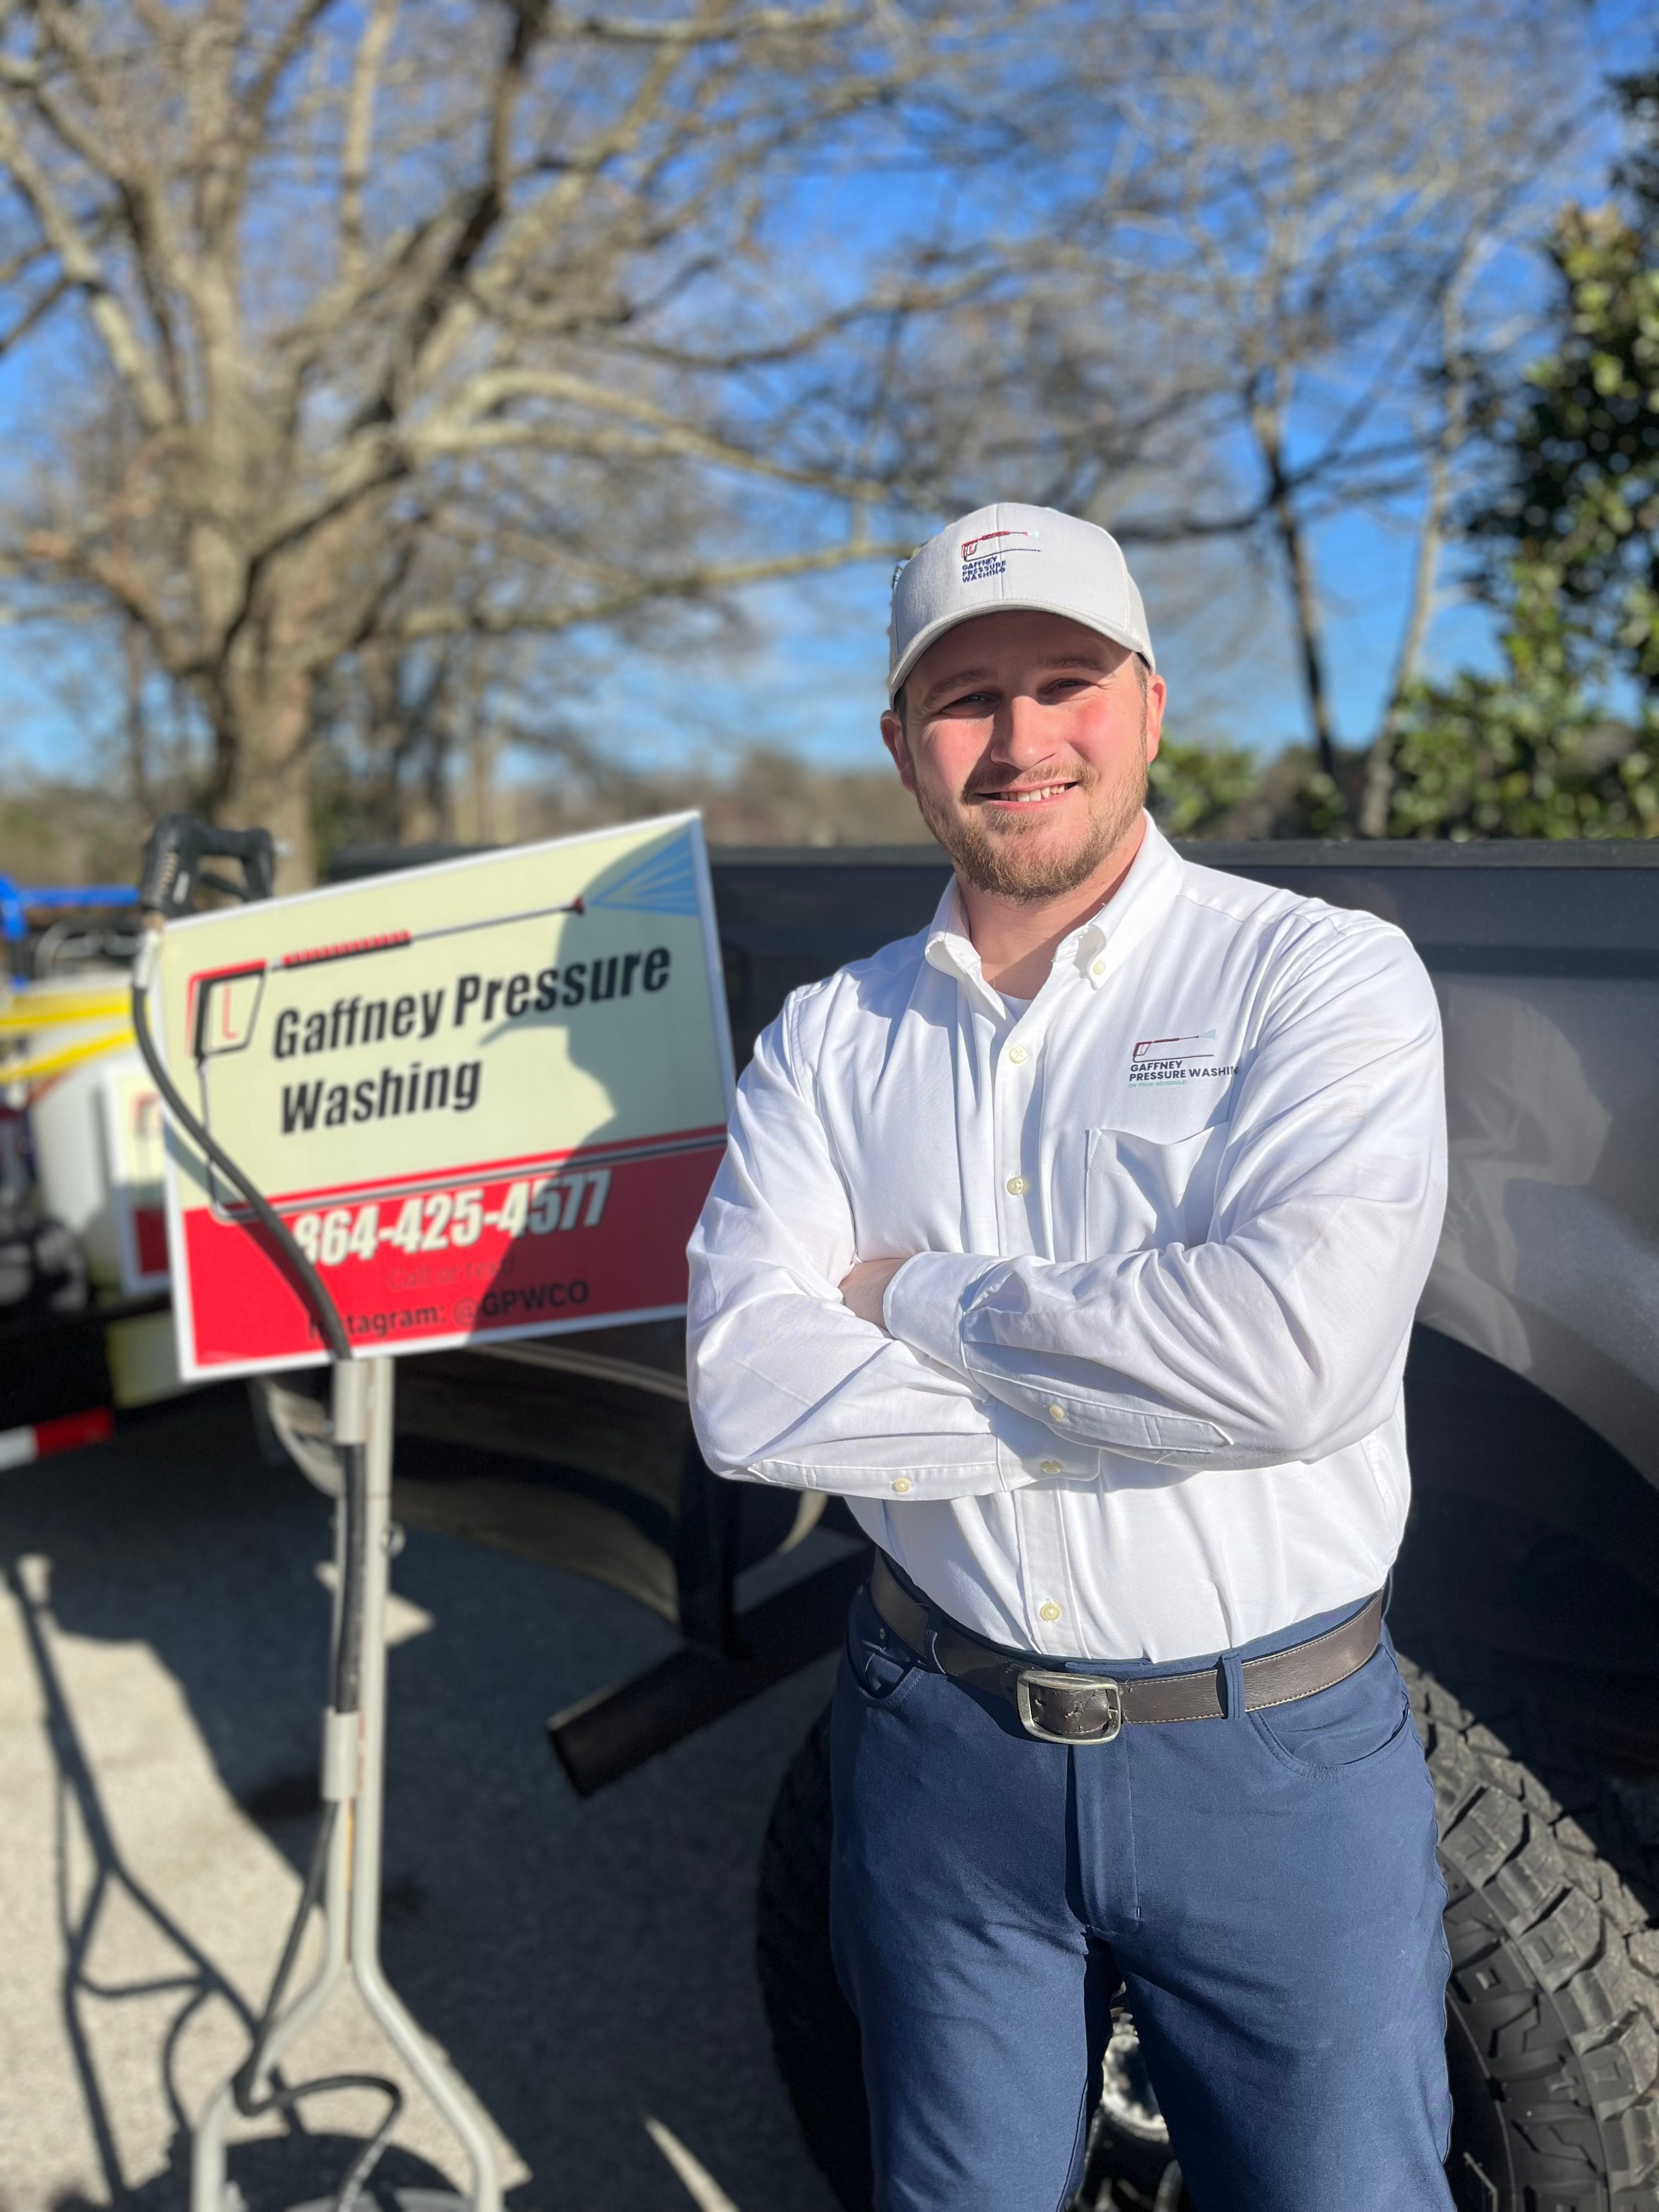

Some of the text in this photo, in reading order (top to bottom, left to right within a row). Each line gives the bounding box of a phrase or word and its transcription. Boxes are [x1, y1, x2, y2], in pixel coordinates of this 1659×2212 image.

[962, 556, 997, 570] GAFFNEY
[962, 560, 1007, 577] PRESSURE
[962, 567, 1006, 583] WASHING
[275, 946, 671, 1060] Gaffney Pressure
[1129, 1066, 1238, 1081] PRESSURE WASHIN
[1131, 1060, 1183, 1072] GAFFNEY
[281, 1060, 483, 1135] Washing
